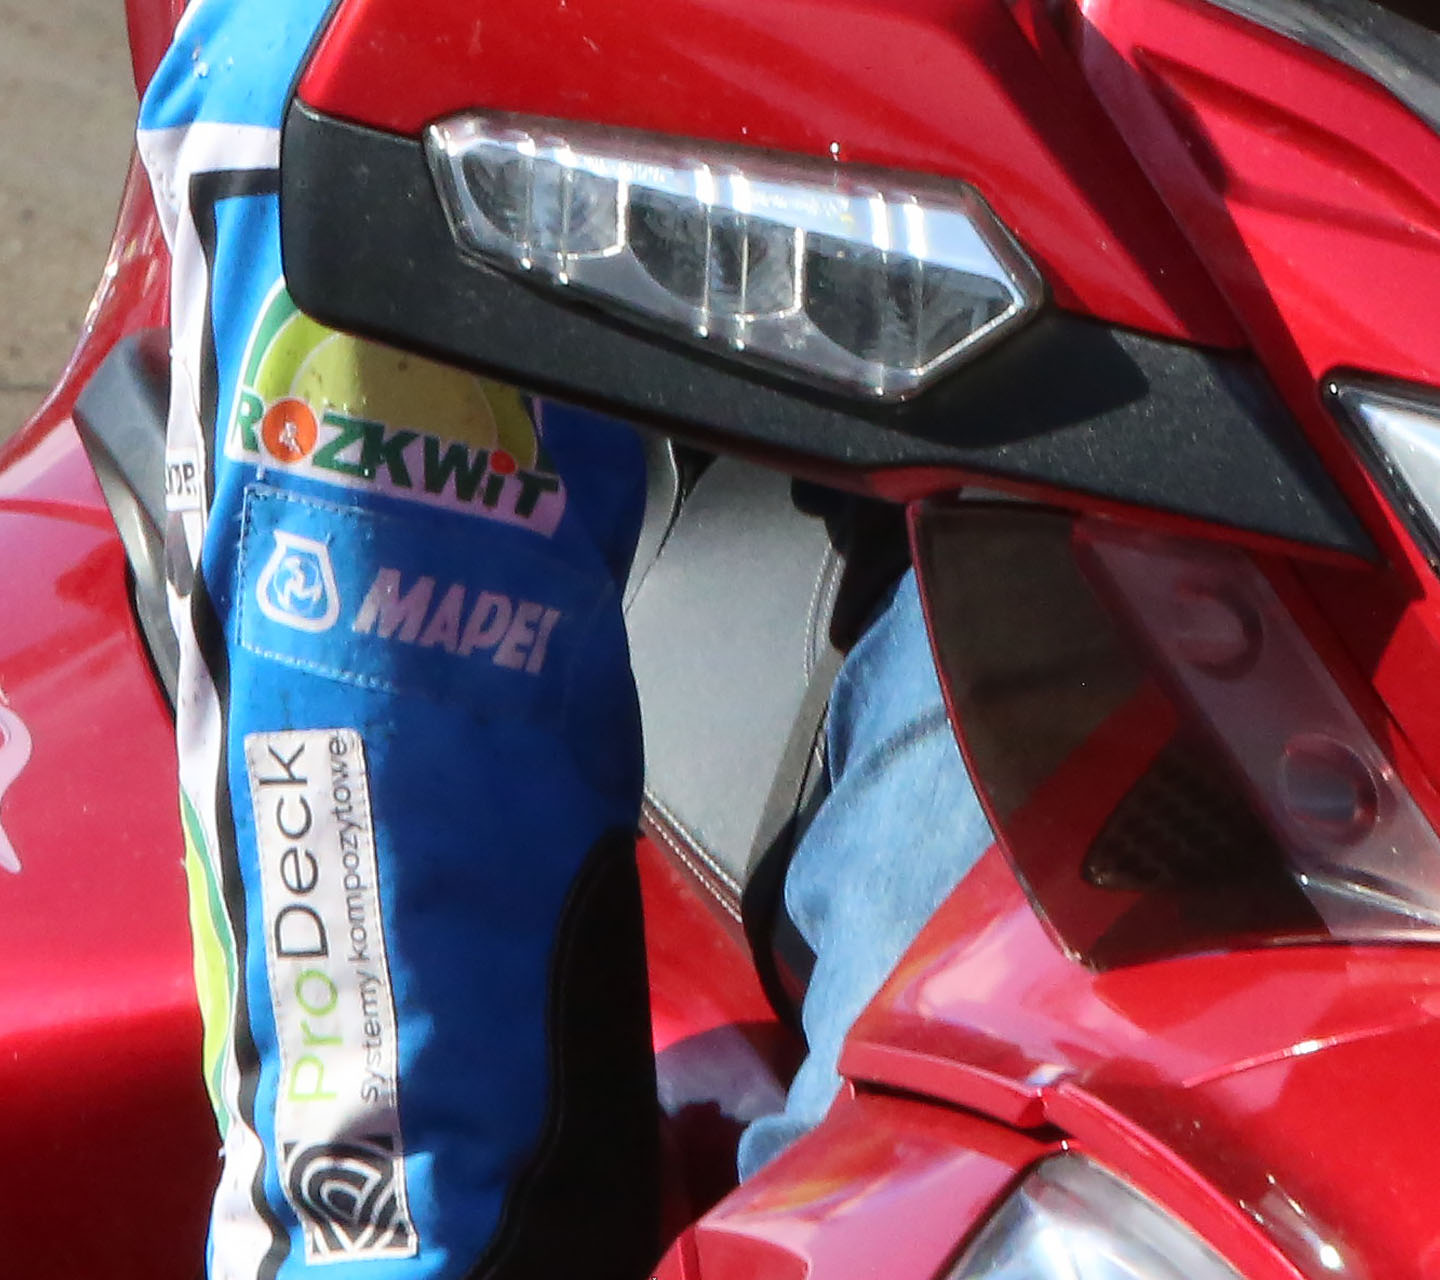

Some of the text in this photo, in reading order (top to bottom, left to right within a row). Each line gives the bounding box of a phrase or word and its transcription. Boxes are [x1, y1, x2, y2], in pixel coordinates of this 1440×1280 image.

[351, 566, 562, 676] MAPEI
[258, 741, 344, 1104] ProDeck
[328, 735, 371, 963] kompozytowe
